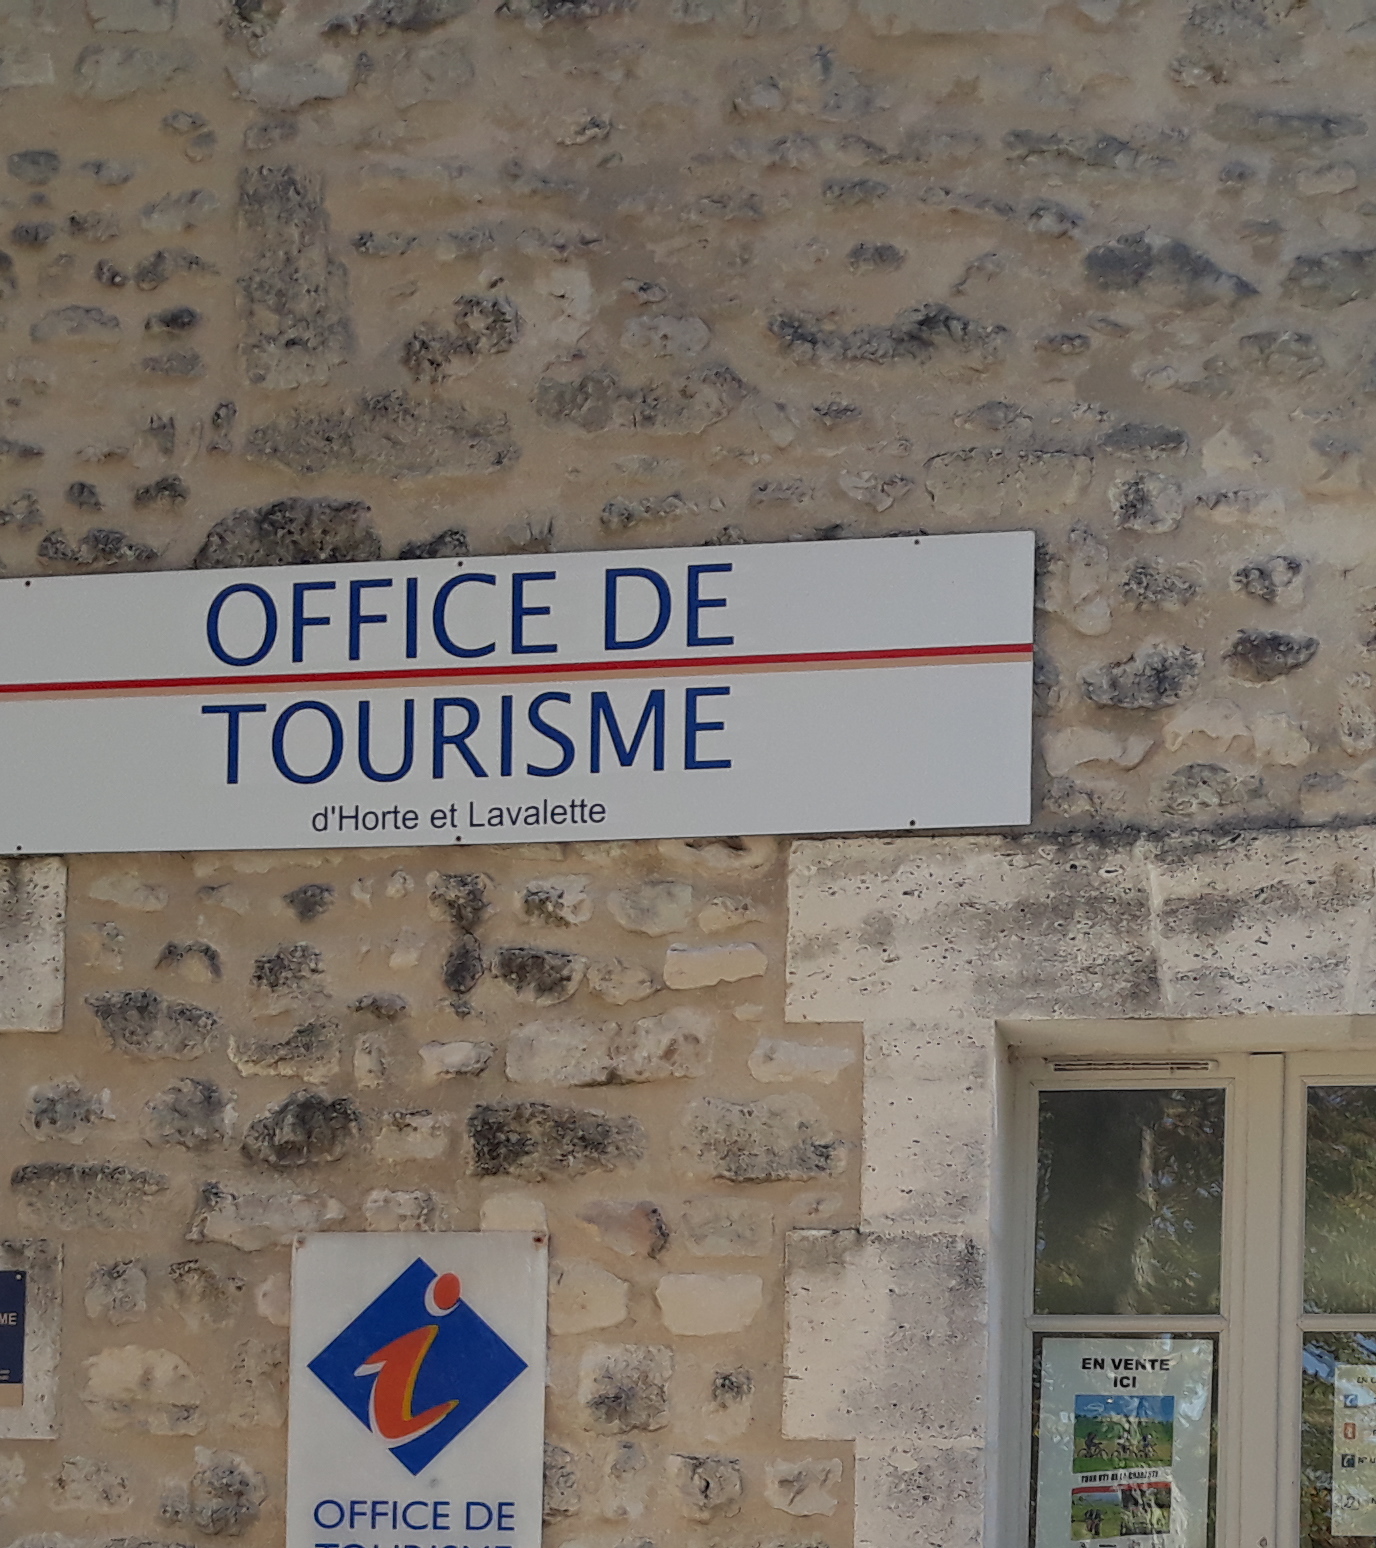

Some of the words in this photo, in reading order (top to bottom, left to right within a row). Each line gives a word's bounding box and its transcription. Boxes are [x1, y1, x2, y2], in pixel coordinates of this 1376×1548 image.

[207, 571, 558, 666] OFFICE
[605, 564, 734, 650] DE
[202, 687, 732, 784] TOURISME
[311, 804, 419, 833] d'Horte
[430, 802, 458, 829] et
[469, 798, 606, 828] Lavalette
[1081, 1357, 1105, 1371] EN
[1110, 1357, 1171, 1371] VENTE
[1113, 1375, 1137, 1389] ICI
[313, 1499, 451, 1532] OFFICE
[465, 1500, 516, 1532] DE
